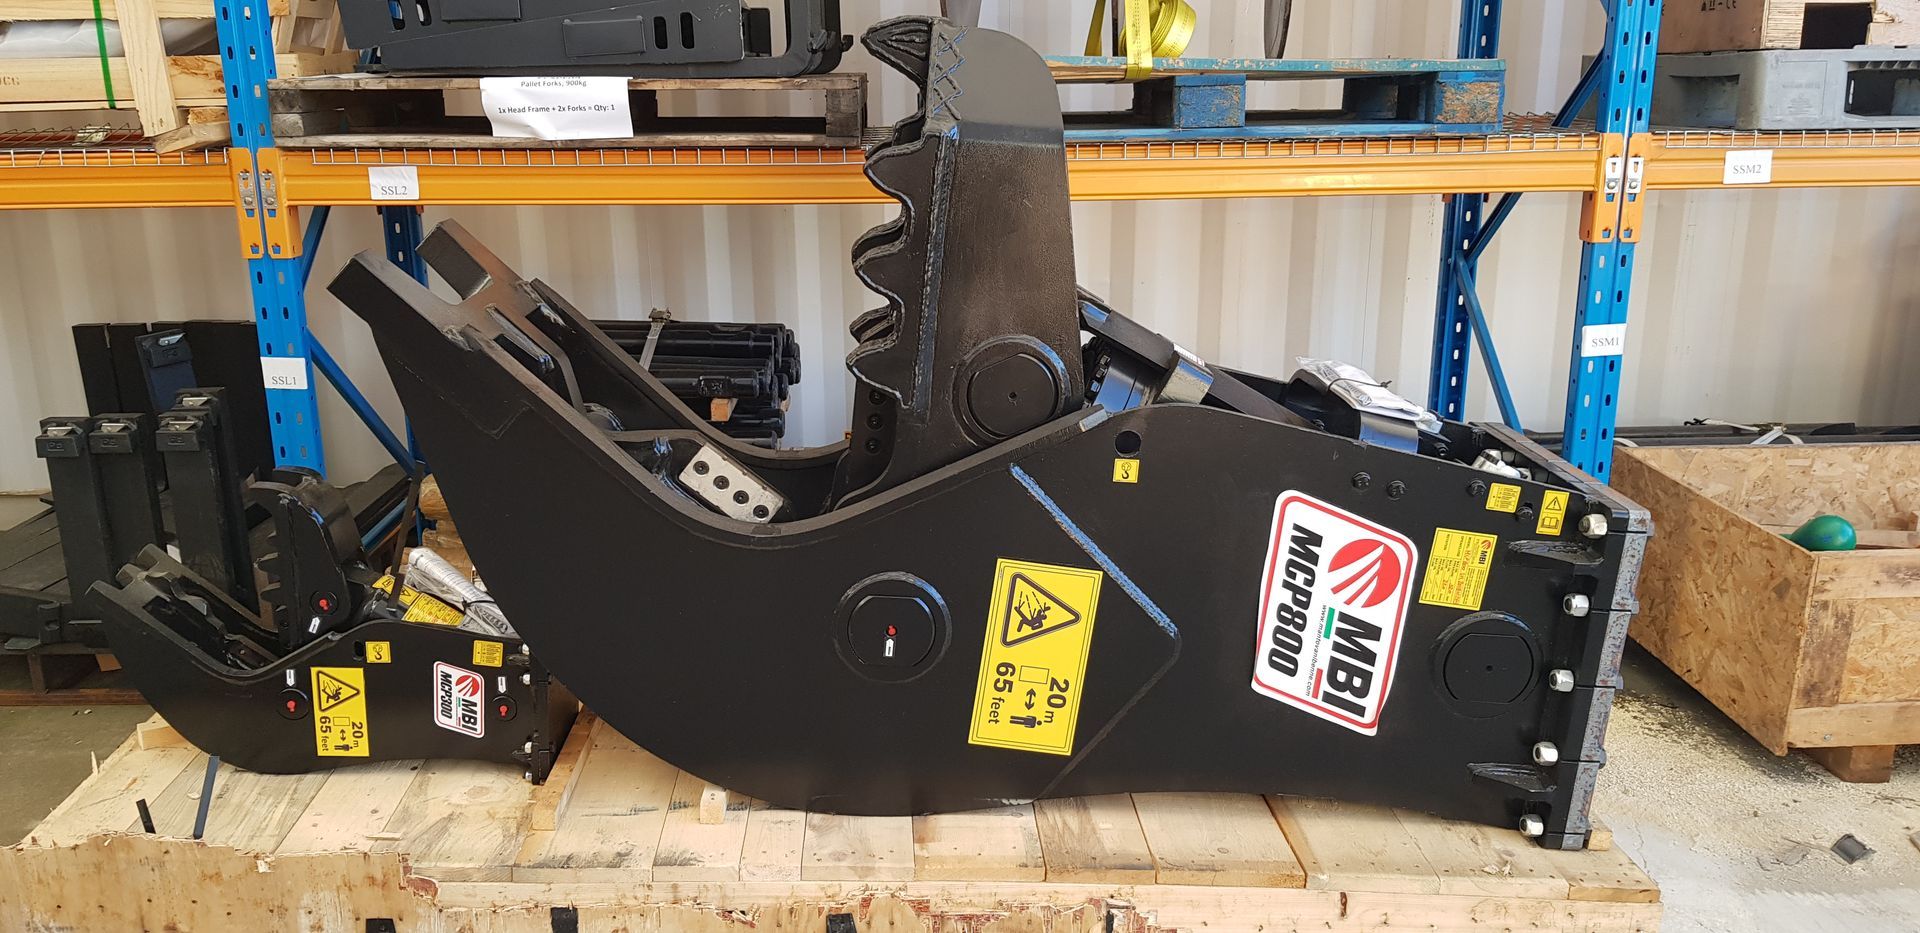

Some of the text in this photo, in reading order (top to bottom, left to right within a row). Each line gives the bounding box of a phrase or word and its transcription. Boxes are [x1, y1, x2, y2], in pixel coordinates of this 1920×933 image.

[543, 80, 564, 88] Forks,
[565, 79, 587, 87] 900kg
[528, 105, 550, 113] Frame
[567, 104, 587, 112] Forks
[593, 104, 609, 112] Qty:
[1732, 164, 1762, 175] SSM2
[381, 185, 408, 196] SSL2
[1591, 336, 1619, 348] SSM1
[271, 375, 297, 386] SSL1
[1478, 550, 1488, 565] MBI
[1267, 522, 1323, 678] MCP800
[1304, 604, 1327, 697] www.mantovanibenne.com
[1321, 610, 1383, 719] MBI
[440, 670, 453, 720] MCP300
[988, 661, 1016, 725] 65 feet
[1043, 677, 1070, 724] 20 m
[461, 698, 478, 732] MBI
[319, 715, 332, 752] 65 feet
[351, 721, 364, 748] 20 m
